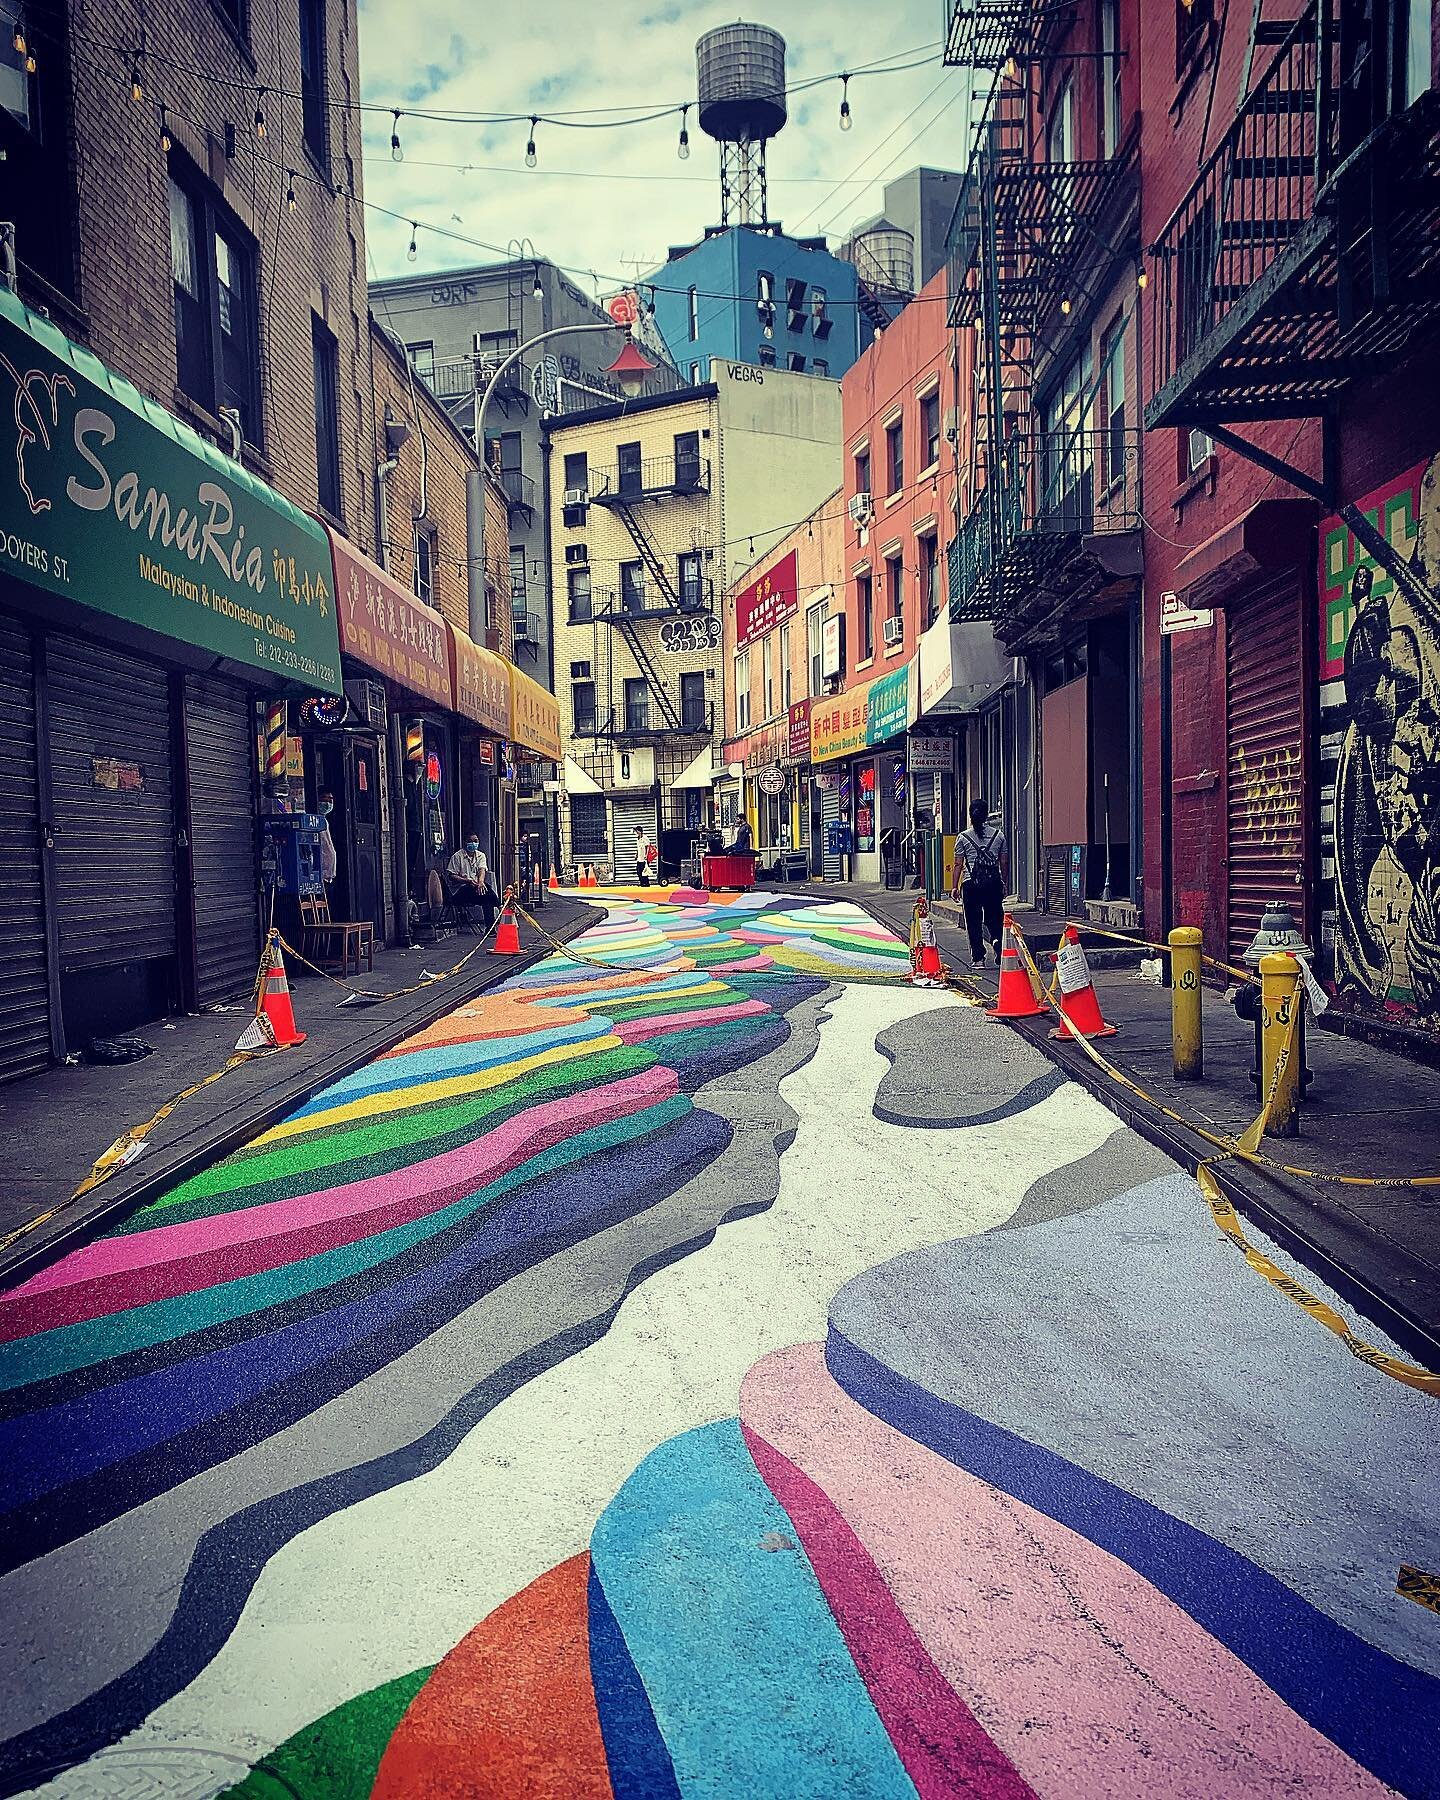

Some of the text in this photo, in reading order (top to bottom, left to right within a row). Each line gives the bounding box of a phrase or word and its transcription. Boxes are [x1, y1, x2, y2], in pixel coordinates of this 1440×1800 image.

[727, 364, 763, 385] VEGAS
[54, 556, 70, 584] ST.
[139, 553, 297, 644] Malaysian & Indonesian Cuisine
[253, 638, 267, 658] Tel:
[819, 744, 829, 756] New
[829, 740, 842, 753] China
[842, 735, 858, 750] Beauty
[1270, 1277, 1321, 1307] CAUTION
